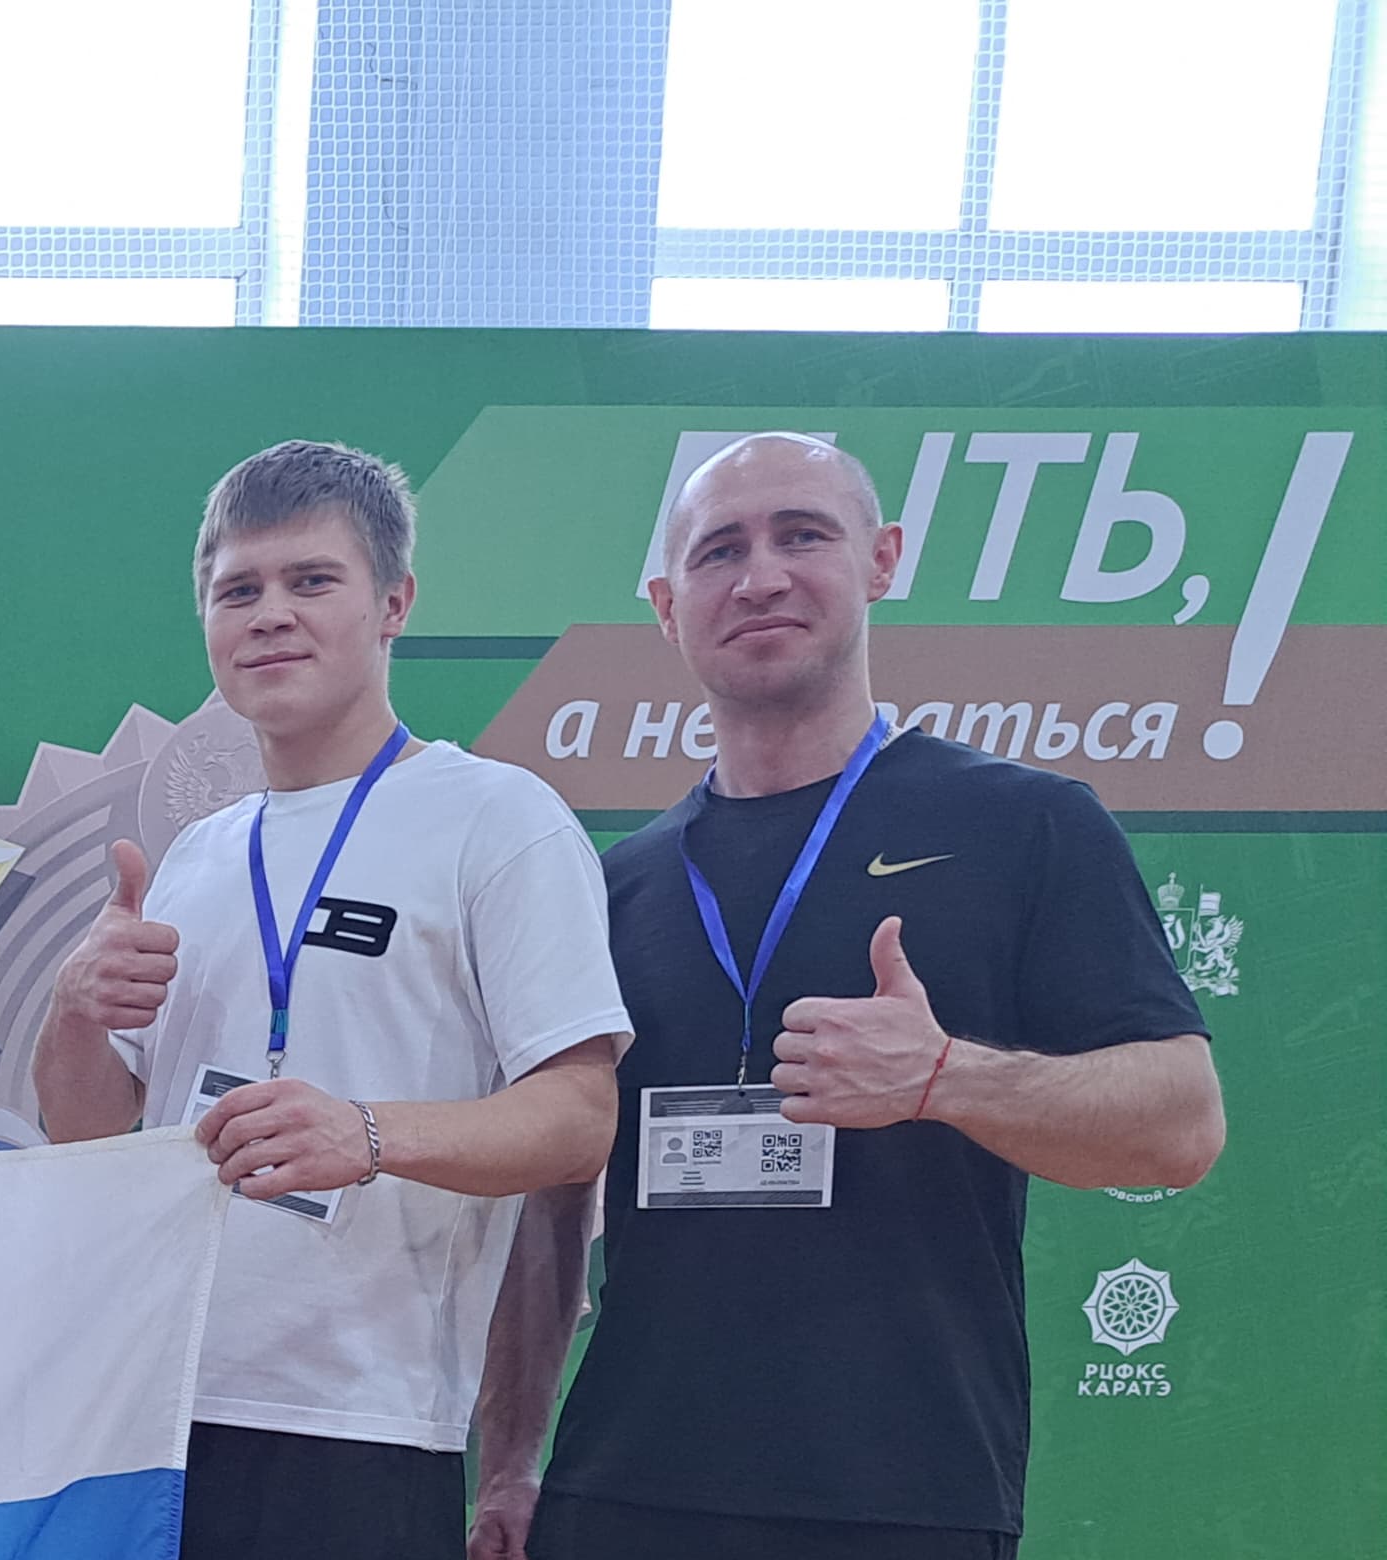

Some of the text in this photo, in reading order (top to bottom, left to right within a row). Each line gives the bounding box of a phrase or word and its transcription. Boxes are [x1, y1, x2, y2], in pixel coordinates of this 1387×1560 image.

[545, 699, 600, 760] а
[622, 701, 719, 760] не
[1084, 1363, 1166, 1381] РЦФКС
[1077, 1380, 1172, 1396] КАРАТЭ
